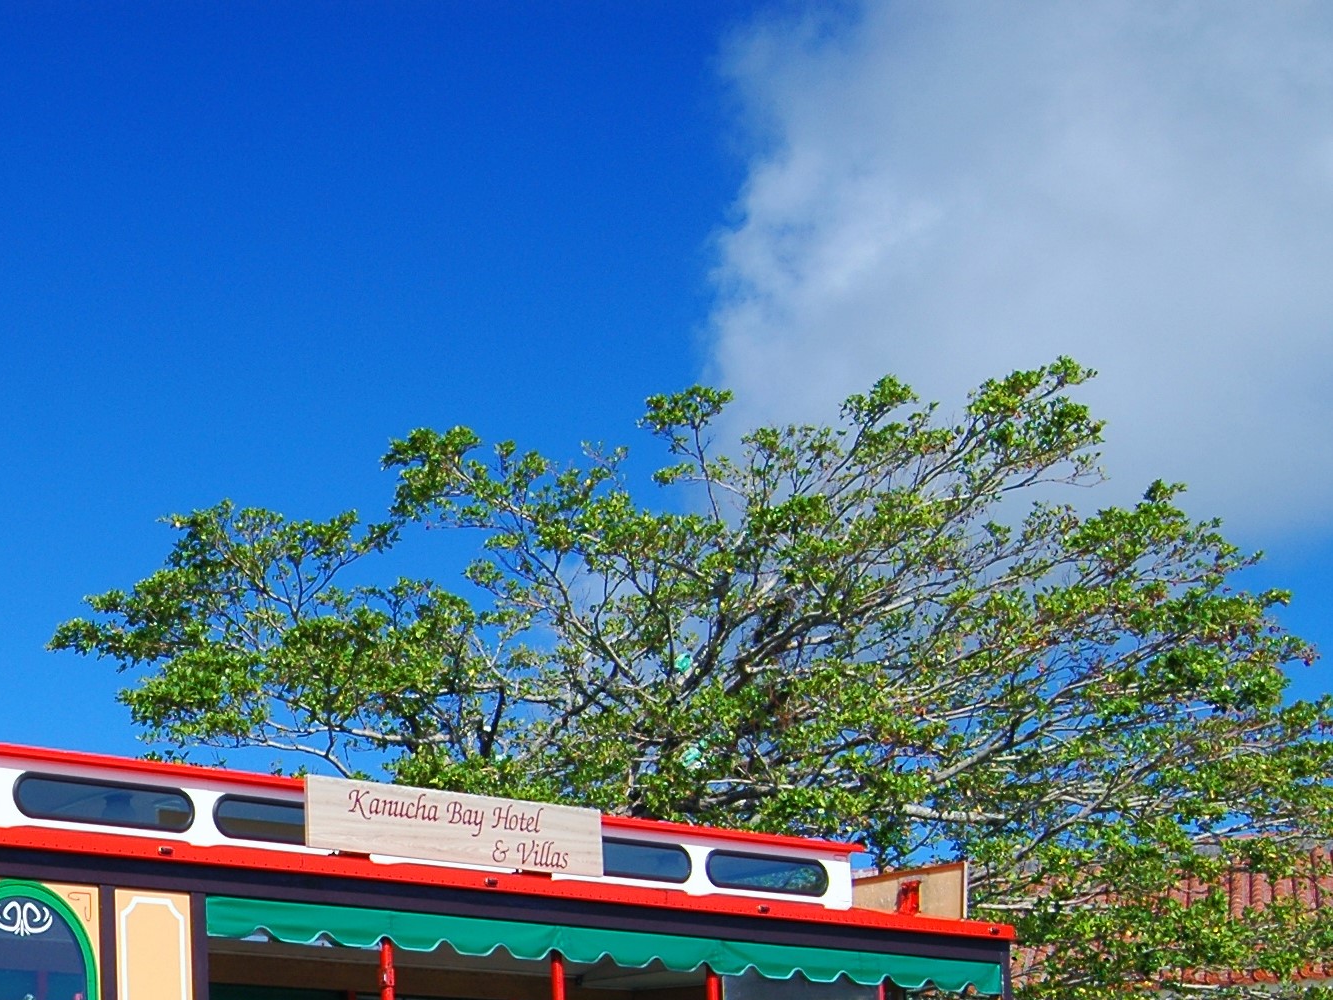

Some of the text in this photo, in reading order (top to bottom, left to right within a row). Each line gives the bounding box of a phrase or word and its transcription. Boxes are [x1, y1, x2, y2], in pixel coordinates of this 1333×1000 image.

[348, 789, 544, 837] Kanucha Bay Hotel
[492, 840, 569, 869] & Villas
